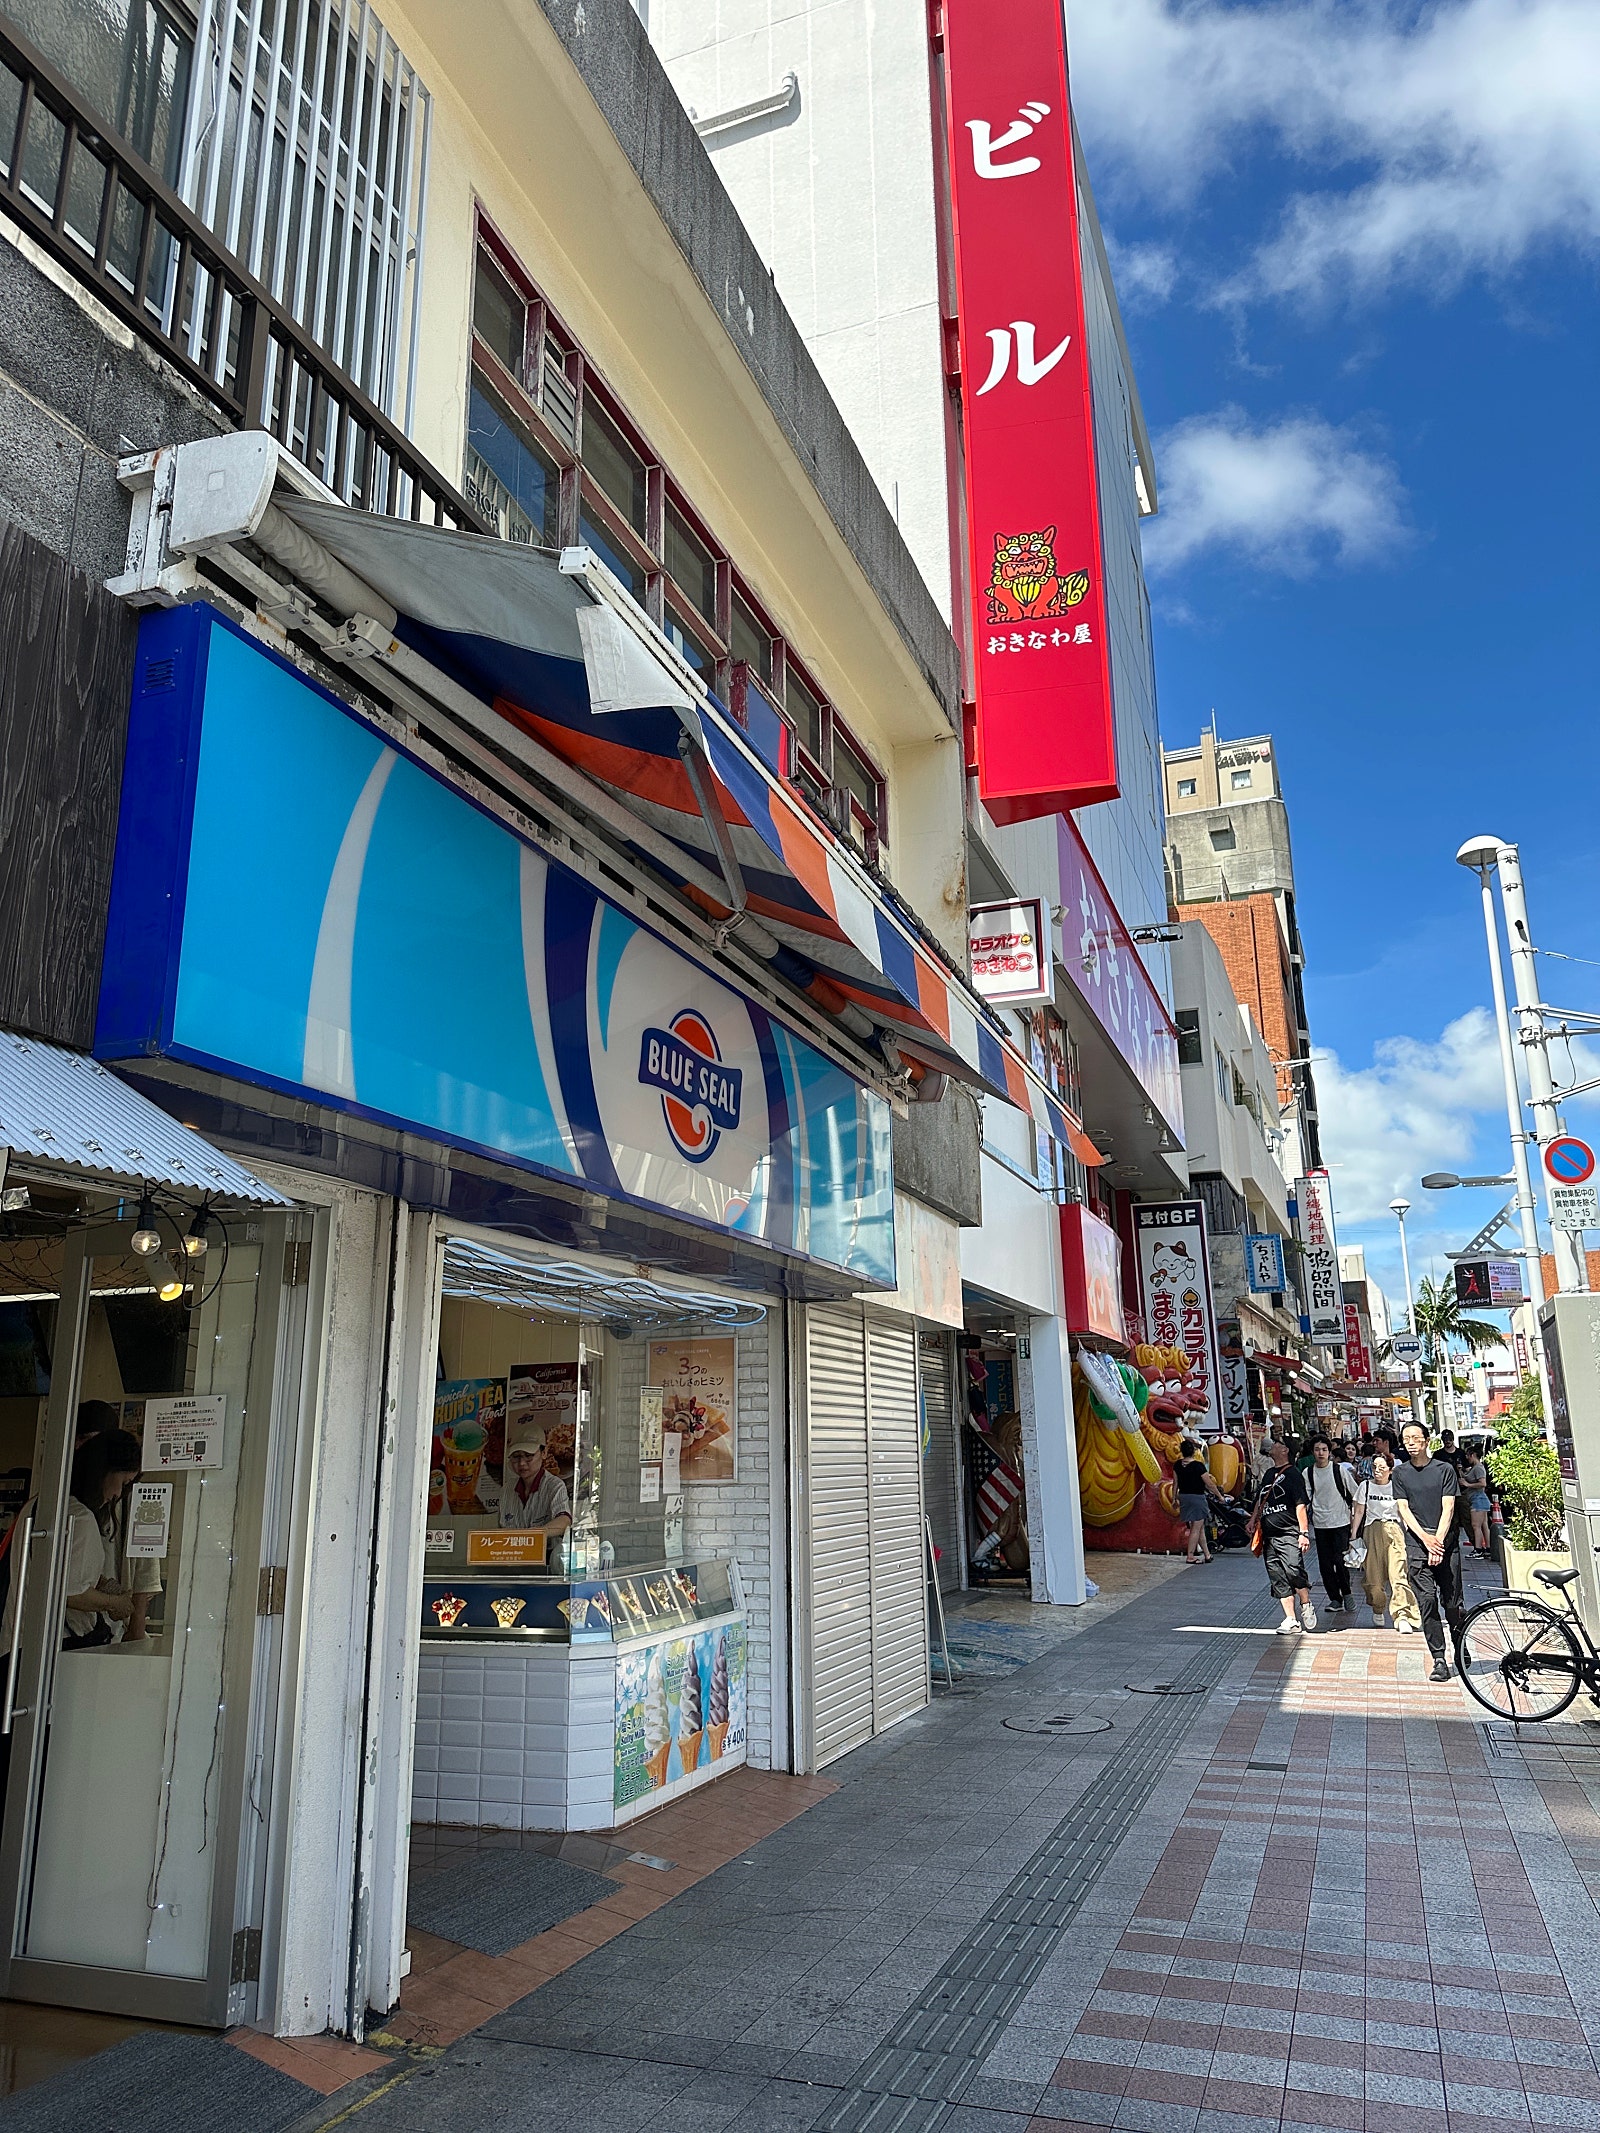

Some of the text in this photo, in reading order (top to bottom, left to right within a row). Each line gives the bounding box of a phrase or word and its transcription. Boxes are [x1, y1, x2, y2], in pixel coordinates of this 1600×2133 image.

[987, 623, 1092, 654] おきなわ屋
[970, 934, 1020, 952] カラオケ
[971, 952, 1033, 975] ねきねこ
[648, 1039, 736, 1116] BLUE SEAL
[1140, 1209, 1196, 1225] 受付6F
[1560, 1219, 1596, 1227] ここまで
[1307, 1248, 1335, 1309] 波照間
[1182, 1308, 1211, 1393] カラオケ
[535, 1367, 567, 1379] California
[679, 1357, 707, 1375] 3つの
[662, 1377, 724, 1387] おいしさのヒミツ
[997, 1362, 1007, 1411] コインロッ
[1224, 1355, 1245, 1414] ラーメン
[436, 1384, 469, 1405] opical
[530, 1396, 570, 1411] Pie
[434, 1385, 504, 1426] RUITS TEA
[479, 1404, 507, 1424] Float
[727, 1728, 745, 1748] ¥400
